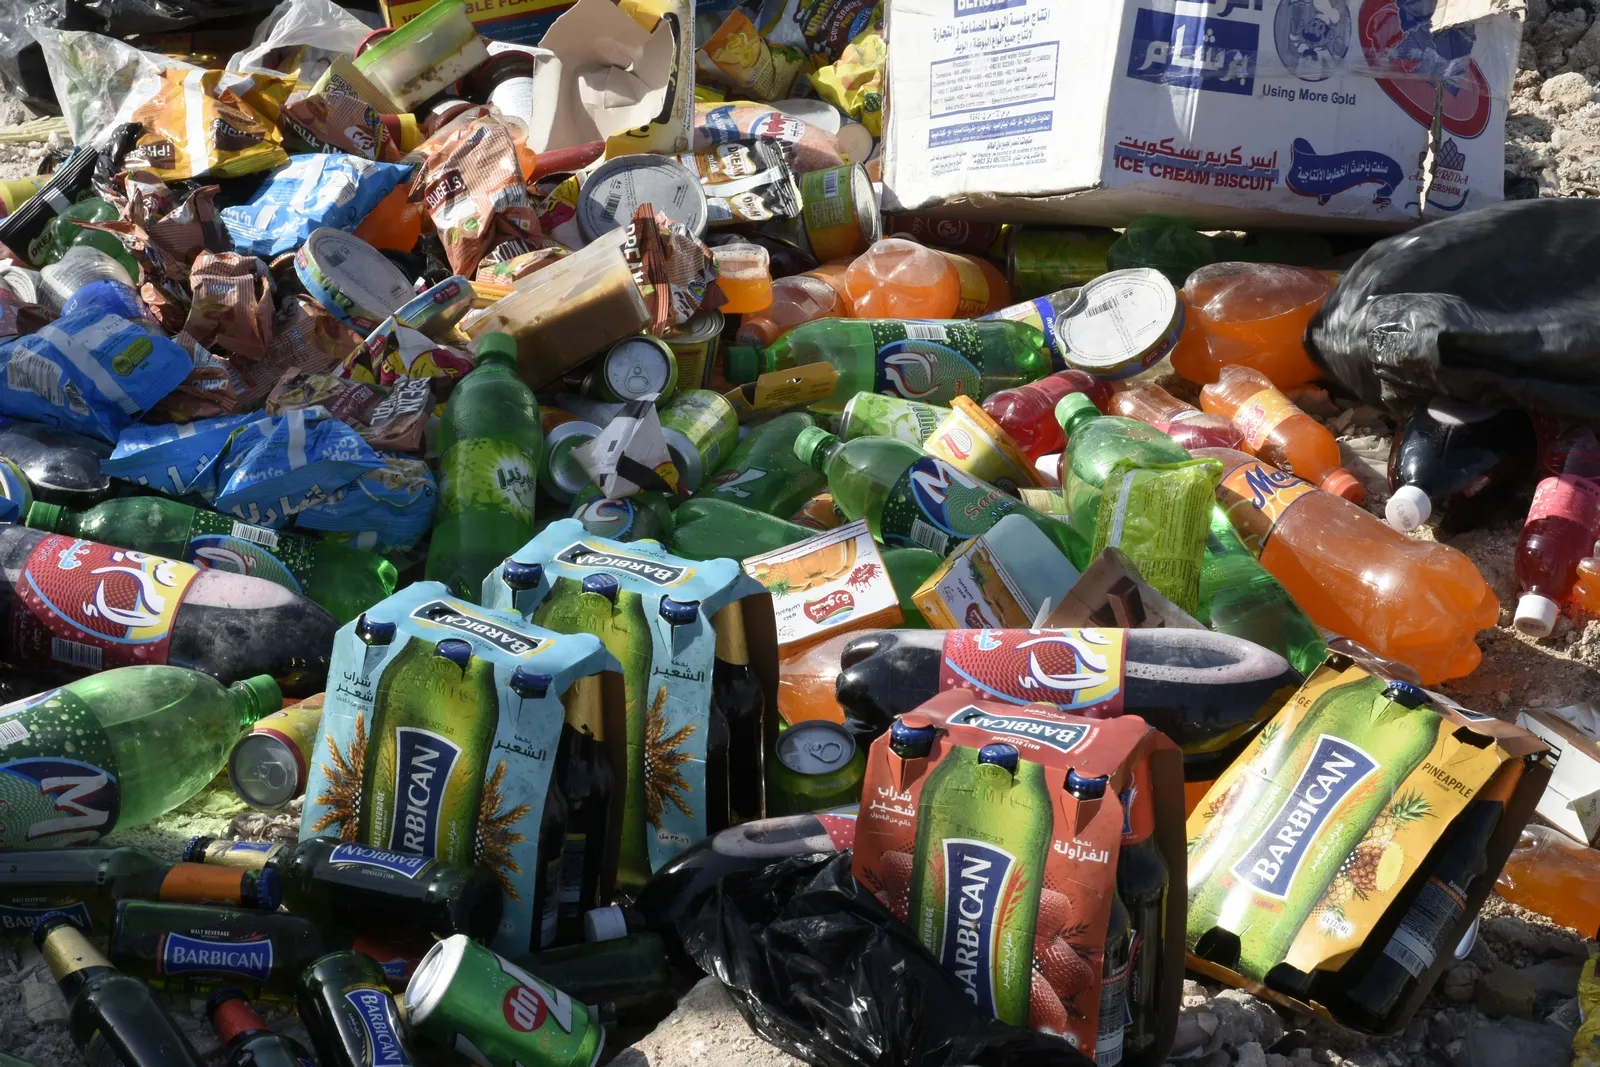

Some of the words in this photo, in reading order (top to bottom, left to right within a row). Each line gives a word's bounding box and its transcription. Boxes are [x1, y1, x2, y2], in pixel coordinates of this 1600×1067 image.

[1263, 84, 1296, 102] Using
[1299, 88, 1328, 104] More
[1331, 92, 1356, 106] Gold
[1117, 136, 1201, 163] بسكويت
[1202, 145, 1243, 170] كريم
[1114, 154, 1144, 174] ICE
[1149, 162, 1211, 187] CREAM
[1214, 170, 1277, 192] BISCUIT
[426, 175, 466, 209] BUGELS
[30, 231, 53, 259] DREA
[344, 671, 371, 688] شراب
[653, 666, 706, 683] الشعير
[336, 684, 373, 703] شعير
[494, 738, 548, 762] الشعير
[1421, 762, 1474, 799] PINEAPPLE
[404, 743, 440, 856] RBICAN
[878, 785, 912, 802] شراب
[374, 791, 385, 829] BEVERAGE
[869, 799, 916, 817] شعير
[1250, 750, 1358, 885] BARBICAN
[341, 844, 422, 868] BARBICAN
[1053, 840, 1109, 865] الفراولة
[190, 928, 204, 936] MALT
[173, 946, 264, 970] BARBICAN
[360, 994, 401, 1060] BARBICAN
